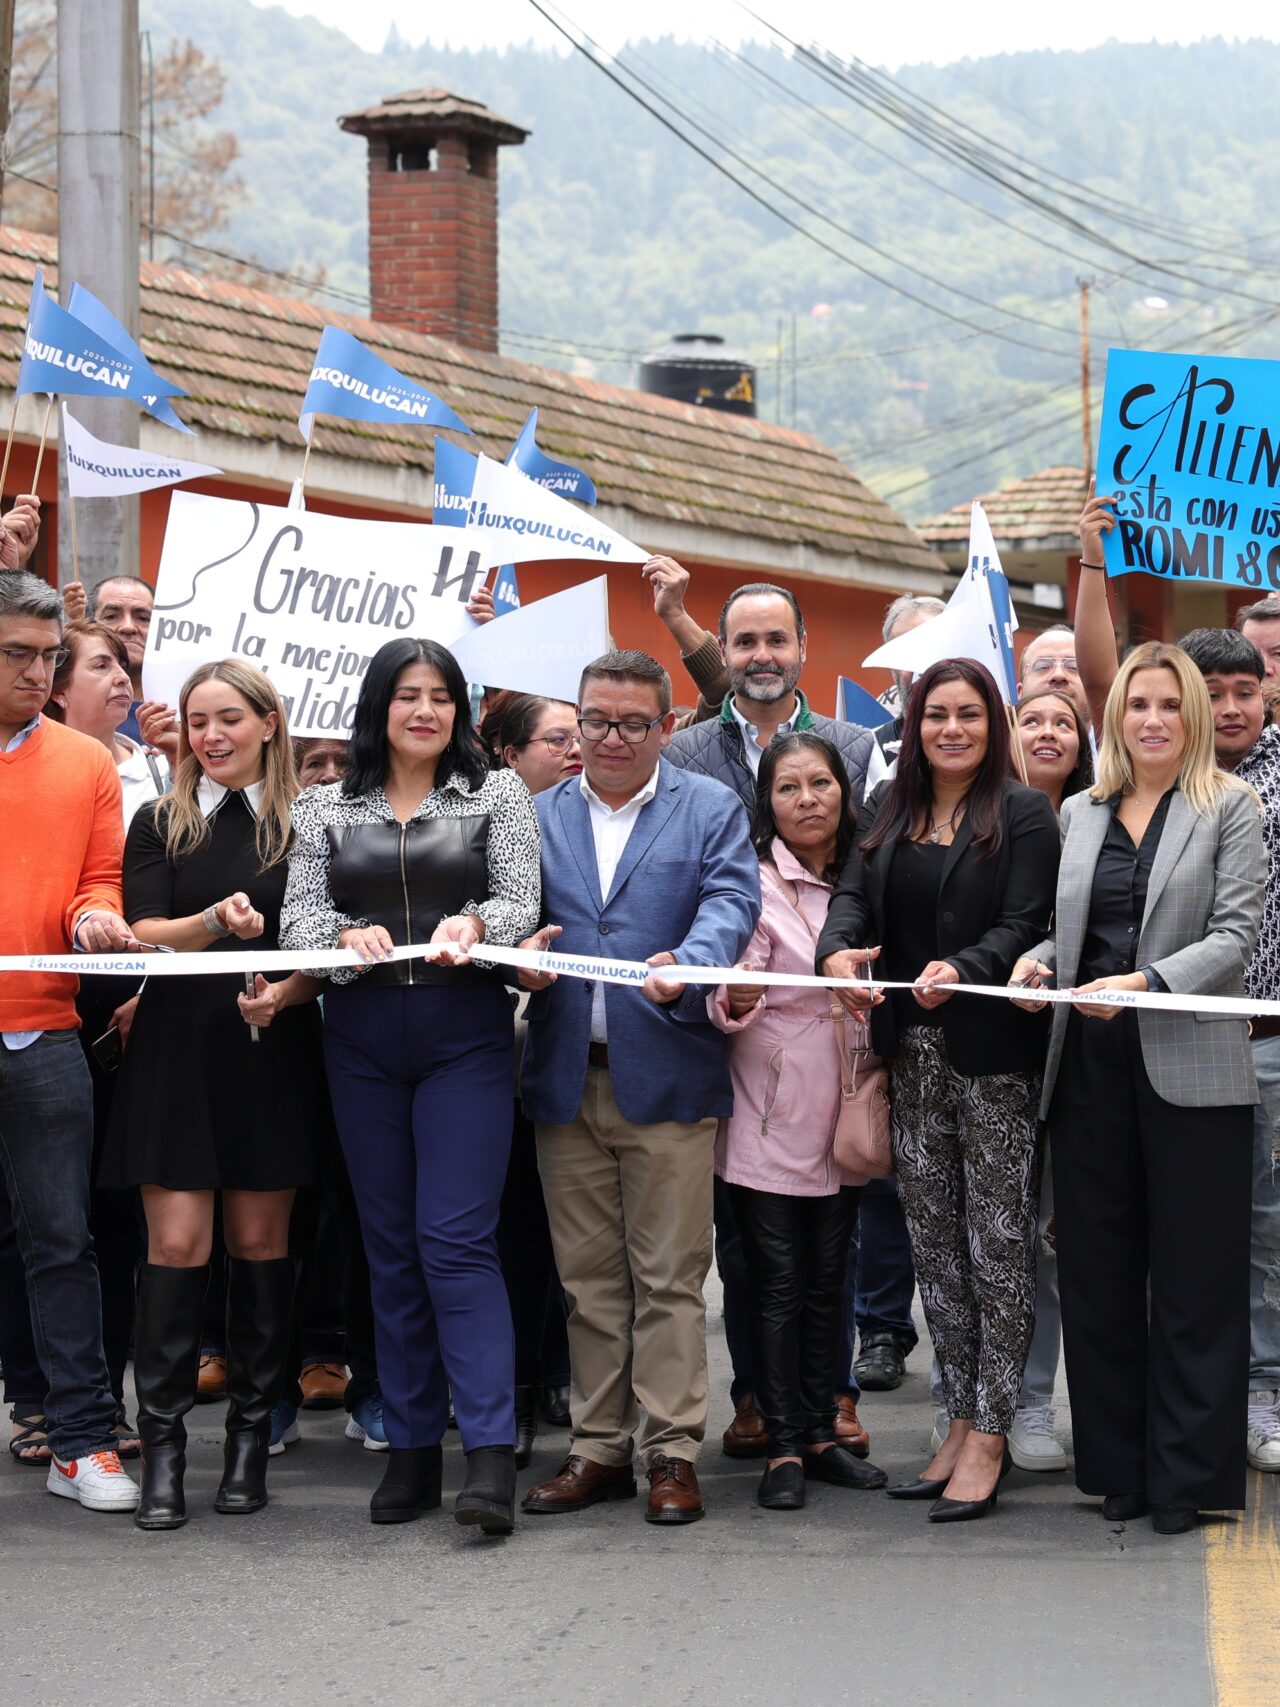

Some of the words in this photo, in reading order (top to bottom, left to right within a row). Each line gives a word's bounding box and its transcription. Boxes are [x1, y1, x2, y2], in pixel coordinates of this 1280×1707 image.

[468, 500, 612, 555] HUIXQUILUCAN
[1112, 474, 1171, 521] esta
[1186, 497, 1238, 530] con
[253, 525, 417, 629] Gracias
[1118, 520, 1224, 579] ROMI
[154, 616, 212, 651] por
[232, 612, 266, 658] la
[281, 640, 376, 685] mejor
